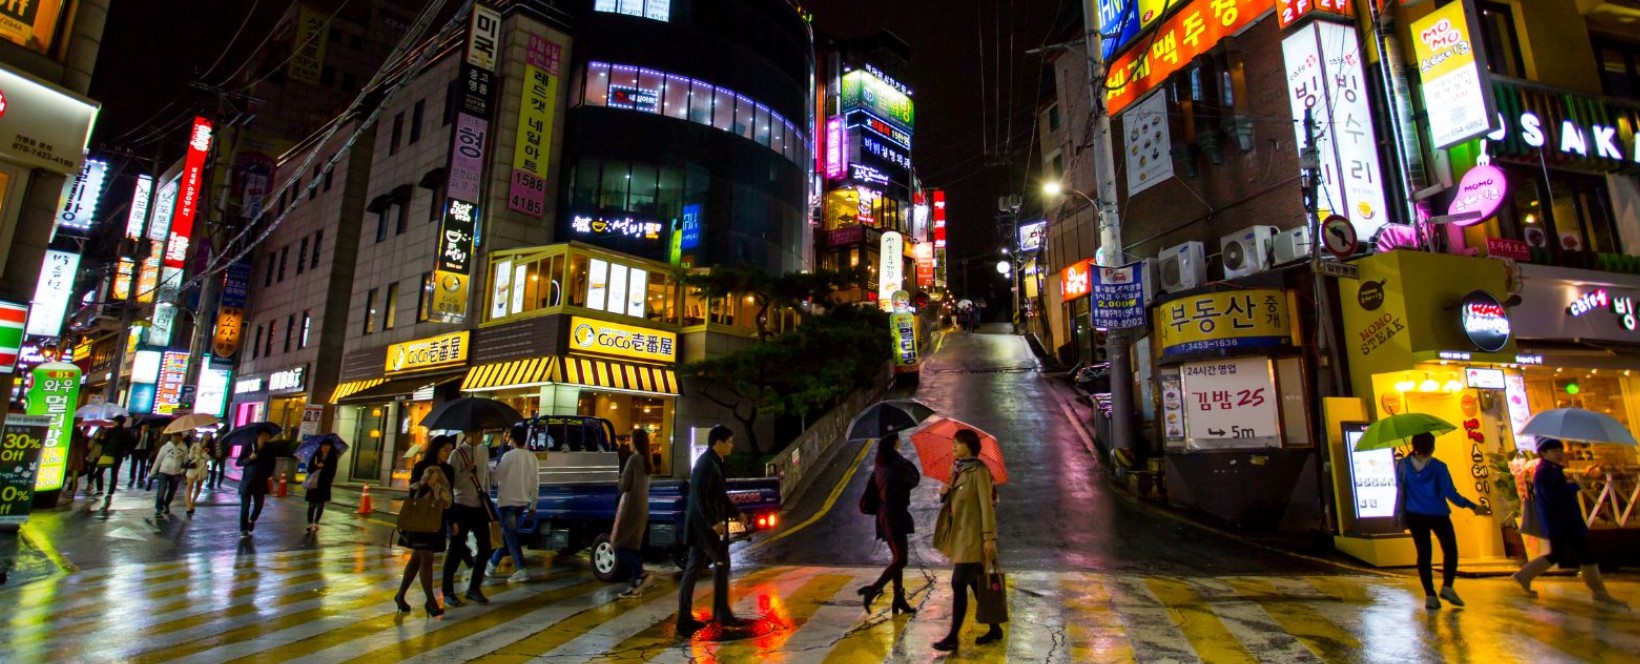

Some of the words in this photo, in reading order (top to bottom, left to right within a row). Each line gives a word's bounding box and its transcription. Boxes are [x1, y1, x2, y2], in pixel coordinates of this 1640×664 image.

[474, 15, 496, 60] 미국
[458, 126, 485, 160] 형
[1335, 73, 1372, 184] 빙수리
[1486, 112, 1640, 164] SAK
[522, 117, 544, 174] 네일아트
[183, 167, 198, 217] www.chop.kr
[515, 173, 543, 192] 1588
[1464, 178, 1494, 193] MOMO
[512, 195, 540, 215] 4185
[1105, 269, 1113, 277] P
[1170, 294, 1257, 334] 부동산
[1264, 295, 1281, 329] 중개
[1360, 312, 1393, 341] MOMO
[1361, 317, 1405, 356] STEAK
[43, 379, 74, 393] 와우
[3, 433, 41, 450] 30%
[1231, 425, 1256, 440] 5m
[1, 449, 25, 462] Off
